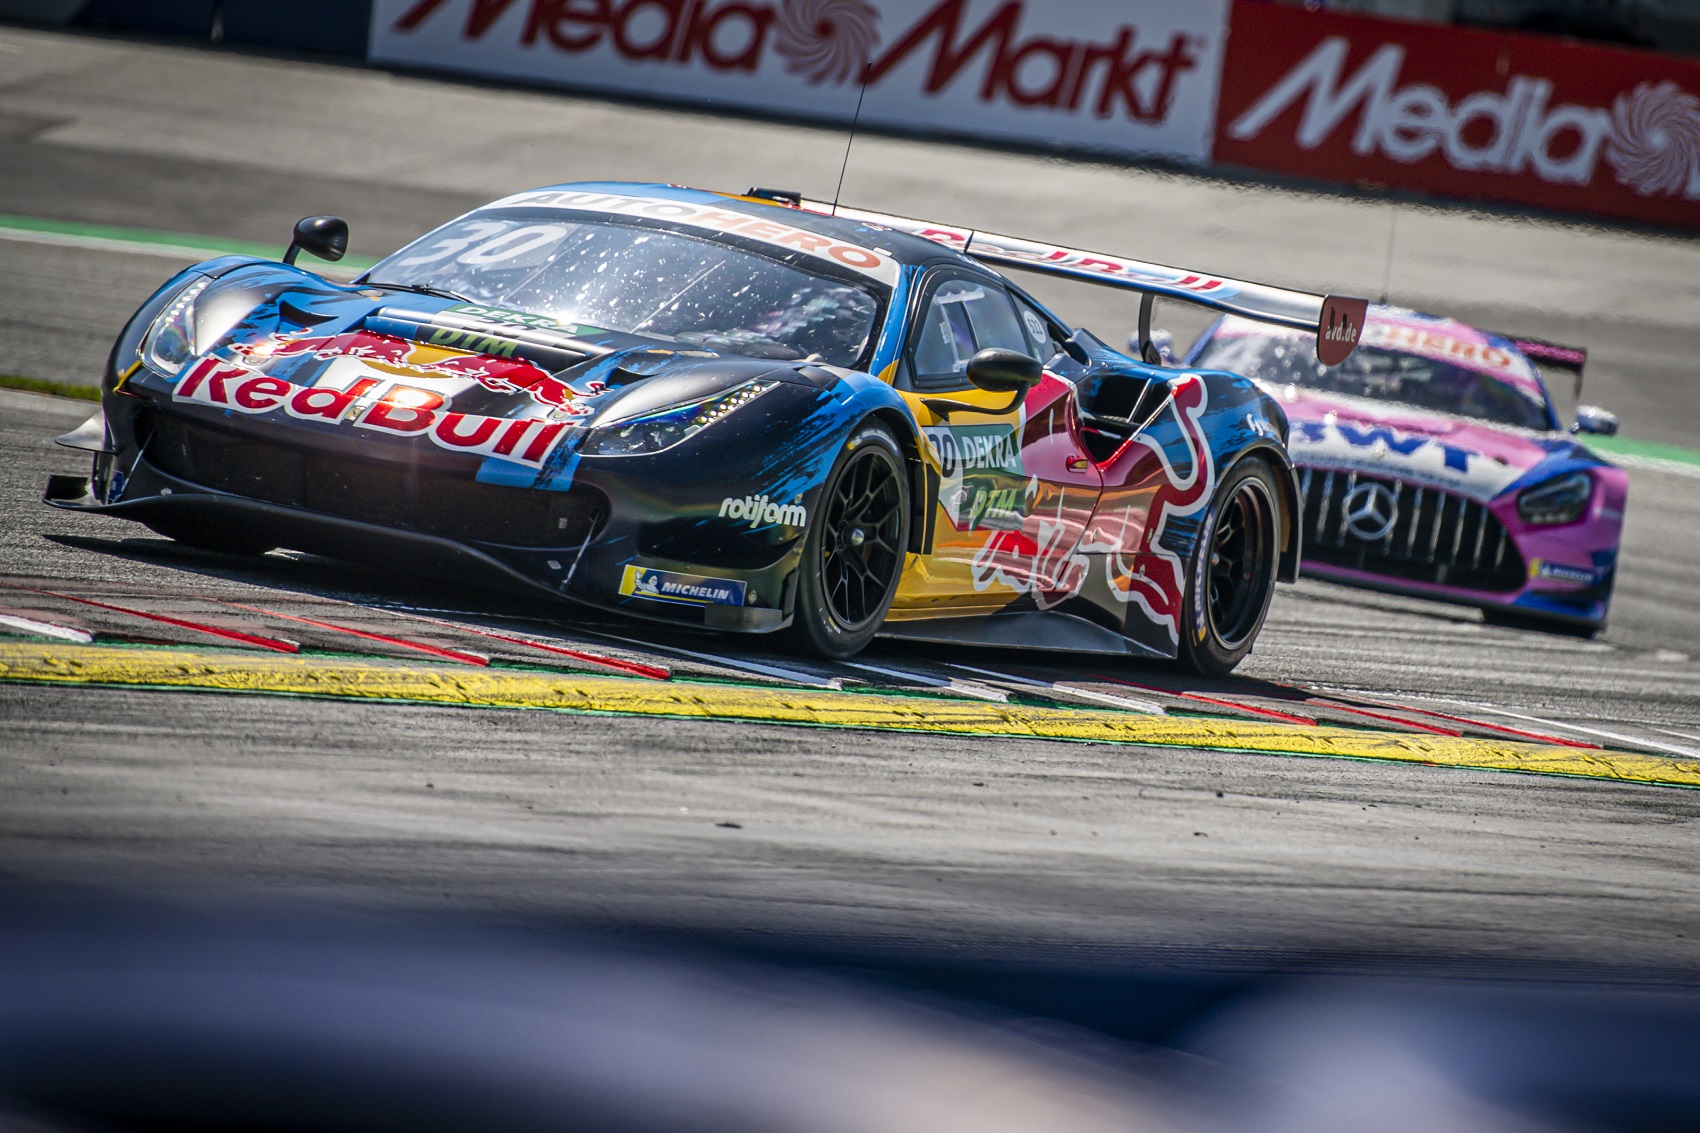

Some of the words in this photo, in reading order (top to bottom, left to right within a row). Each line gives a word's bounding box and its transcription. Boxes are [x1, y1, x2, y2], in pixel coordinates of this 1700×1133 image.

[857, 0, 1197, 125] Markt
[1228, 36, 1608, 186] Media
[399, 221, 569, 268] 30
[527, 191, 881, 269] AUTOHERO
[456, 306, 578, 334] DEKRA
[1325, 321, 1357, 343] avd.de
[428, 326, 519, 358] DTM
[174, 355, 380, 422] Red
[361, 386, 574, 464] Bull
[961, 434, 1017, 469] DEKRA
[718, 494, 807, 529] rotiform
[968, 489, 1018, 519] DTM
[661, 581, 730, 600] MICHELIN
